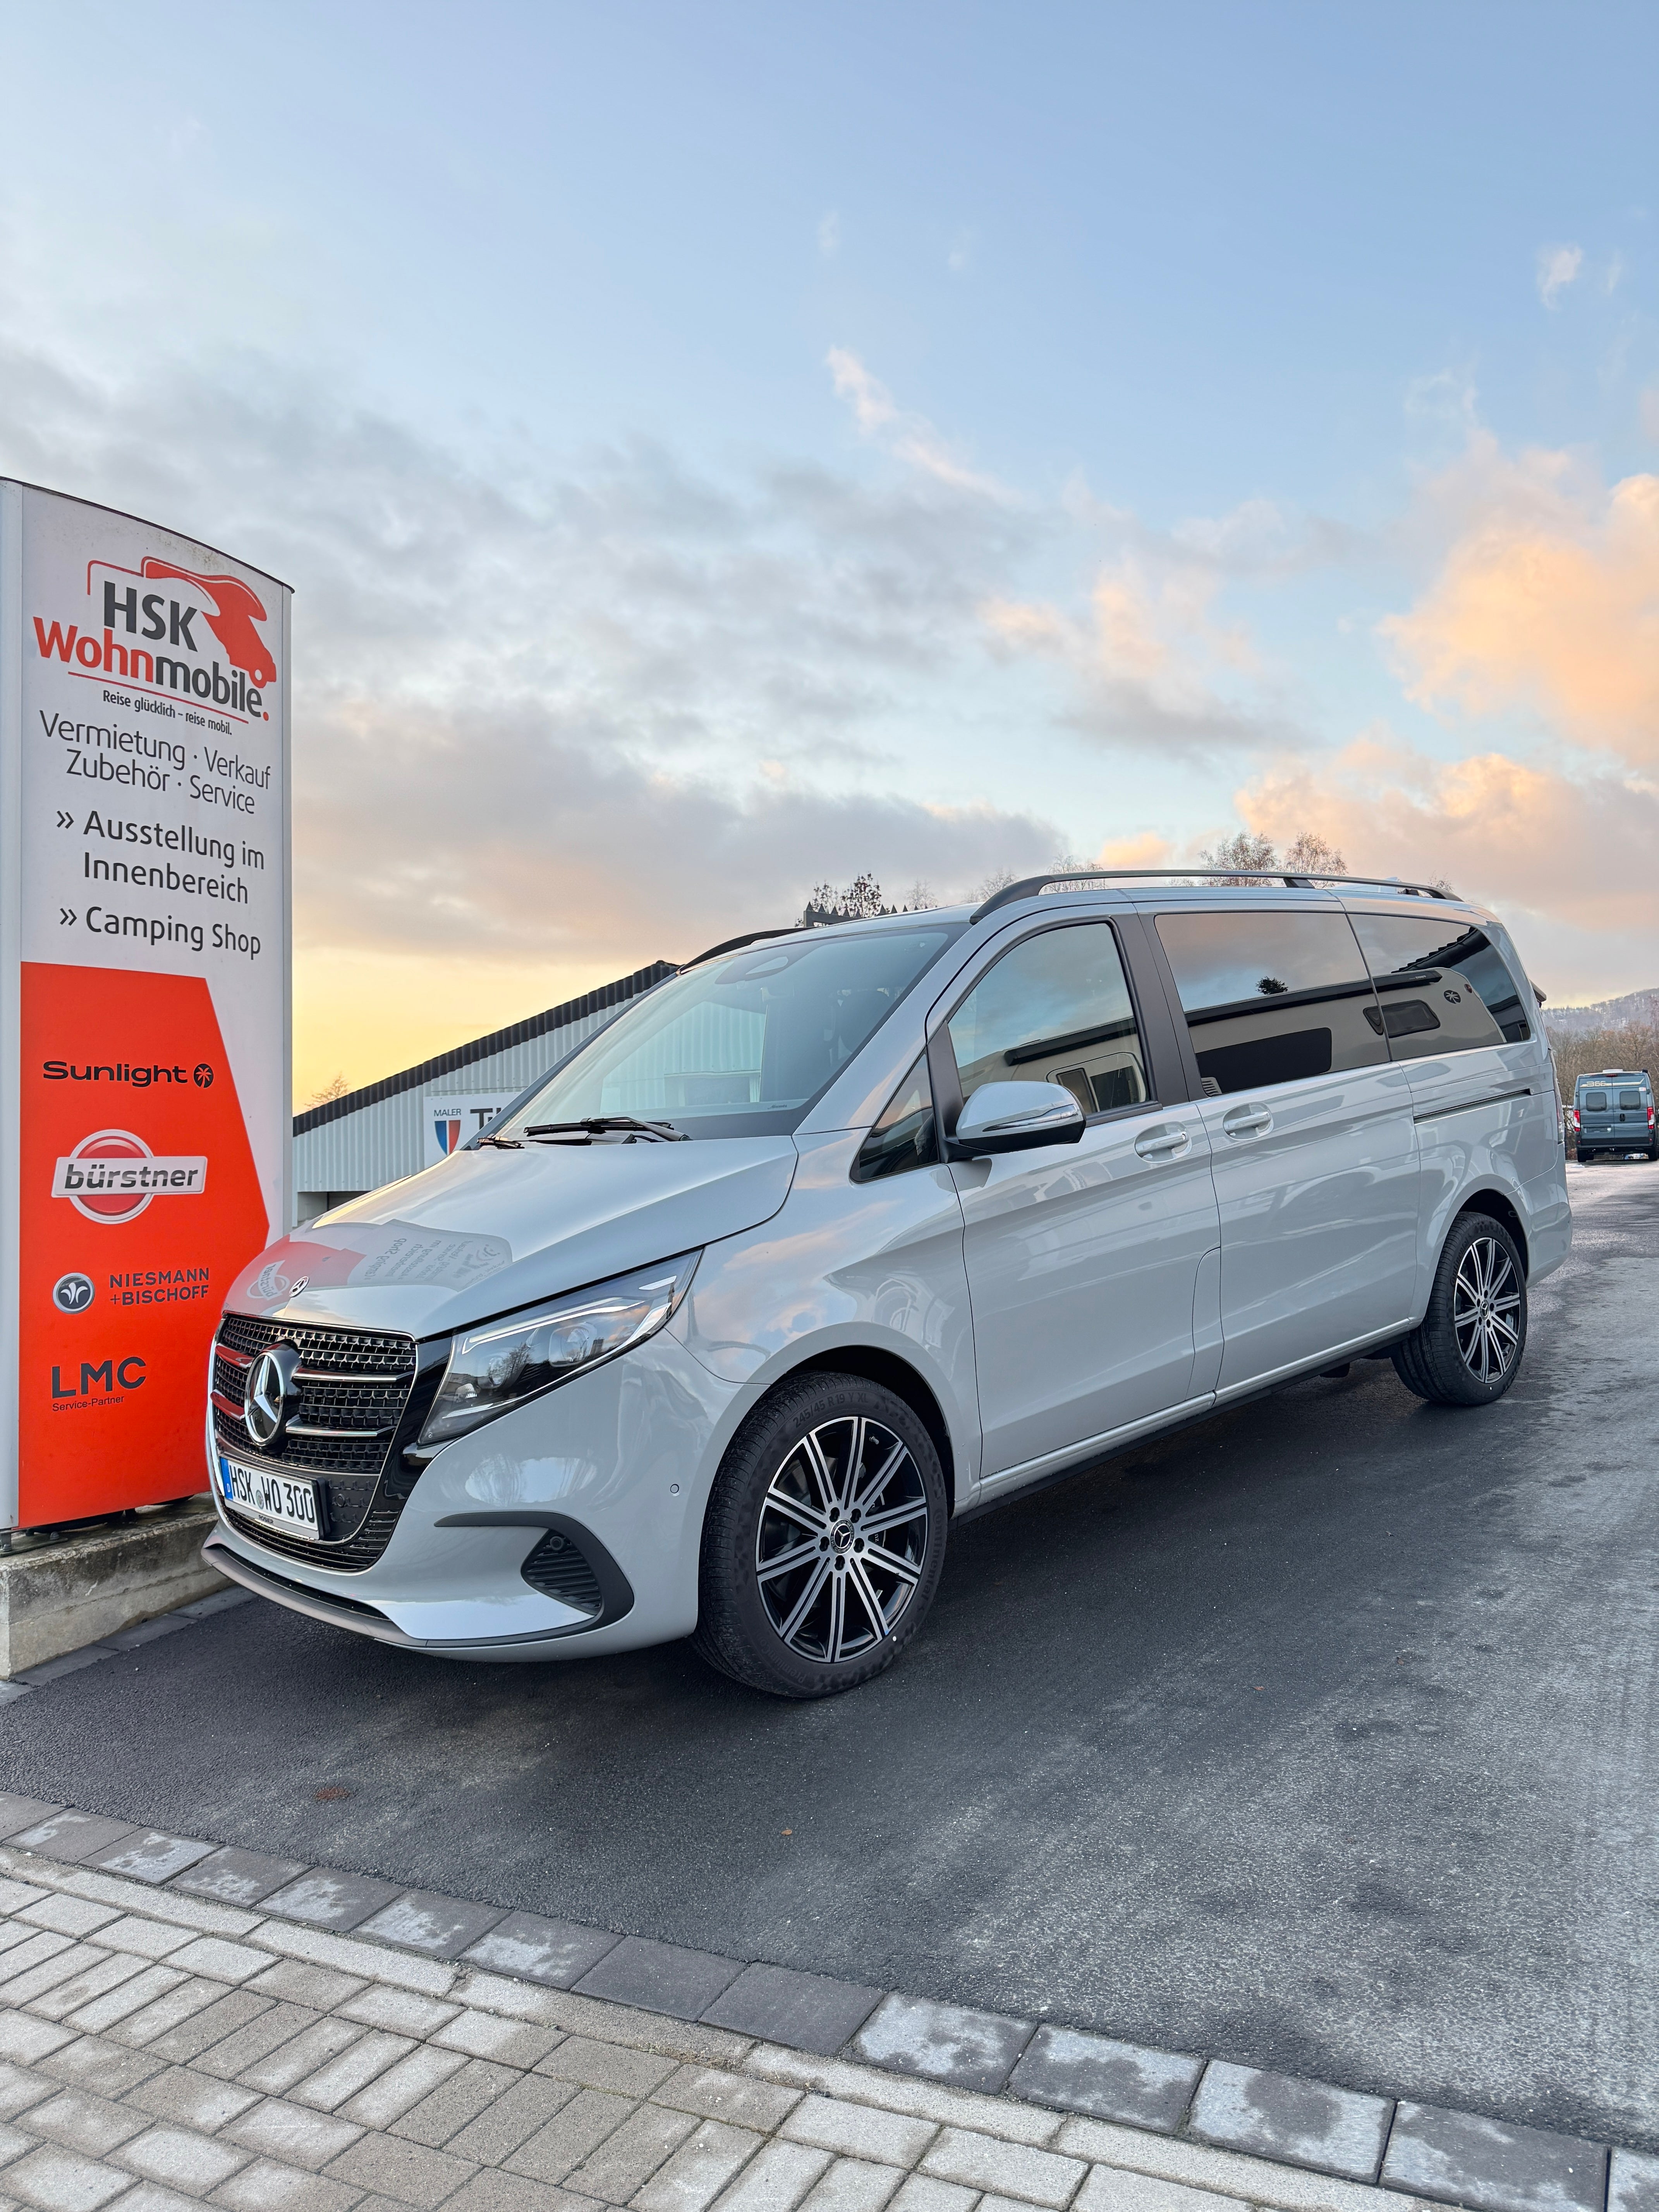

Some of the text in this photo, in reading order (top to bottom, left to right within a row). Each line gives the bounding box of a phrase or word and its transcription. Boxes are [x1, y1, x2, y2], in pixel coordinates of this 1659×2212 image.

[104, 580, 198, 652] HSK
[33, 617, 269, 721] Wohnmobile.
[103, 690, 131, 707] Reise
[134, 699, 175, 719] glücklich
[185, 712, 205, 727] reise
[208, 718, 232, 735] mobil.
[40, 710, 185, 770] Vermietung
[204, 747, 270, 789] Verkauf
[66, 749, 170, 791] Zubehör
[190, 775, 255, 814] Service
[83, 811, 234, 868] Ausstellung
[242, 841, 264, 869] im
[84, 852, 248, 904] Innenbereich
[86, 906, 203, 951] Camping
[212, 924, 261, 960] Shop
[43, 1061, 188, 1087] Sunlight
[434, 1109, 461, 1117] MALER
[64, 1164, 198, 1189] bürstner
[110, 1267, 209, 1288] NIESMANN
[110, 1285, 209, 1305] +BISCHOFF
[52, 1357, 146, 1399] LMC
[52, 1396, 125, 1412] Service-Partner
[793, 1400, 826, 1428] 245/45
[827, 1396, 834, 1407] R
[835, 1394, 845, 1404] 19
[229, 1465, 315, 1523] HSK WO 300
